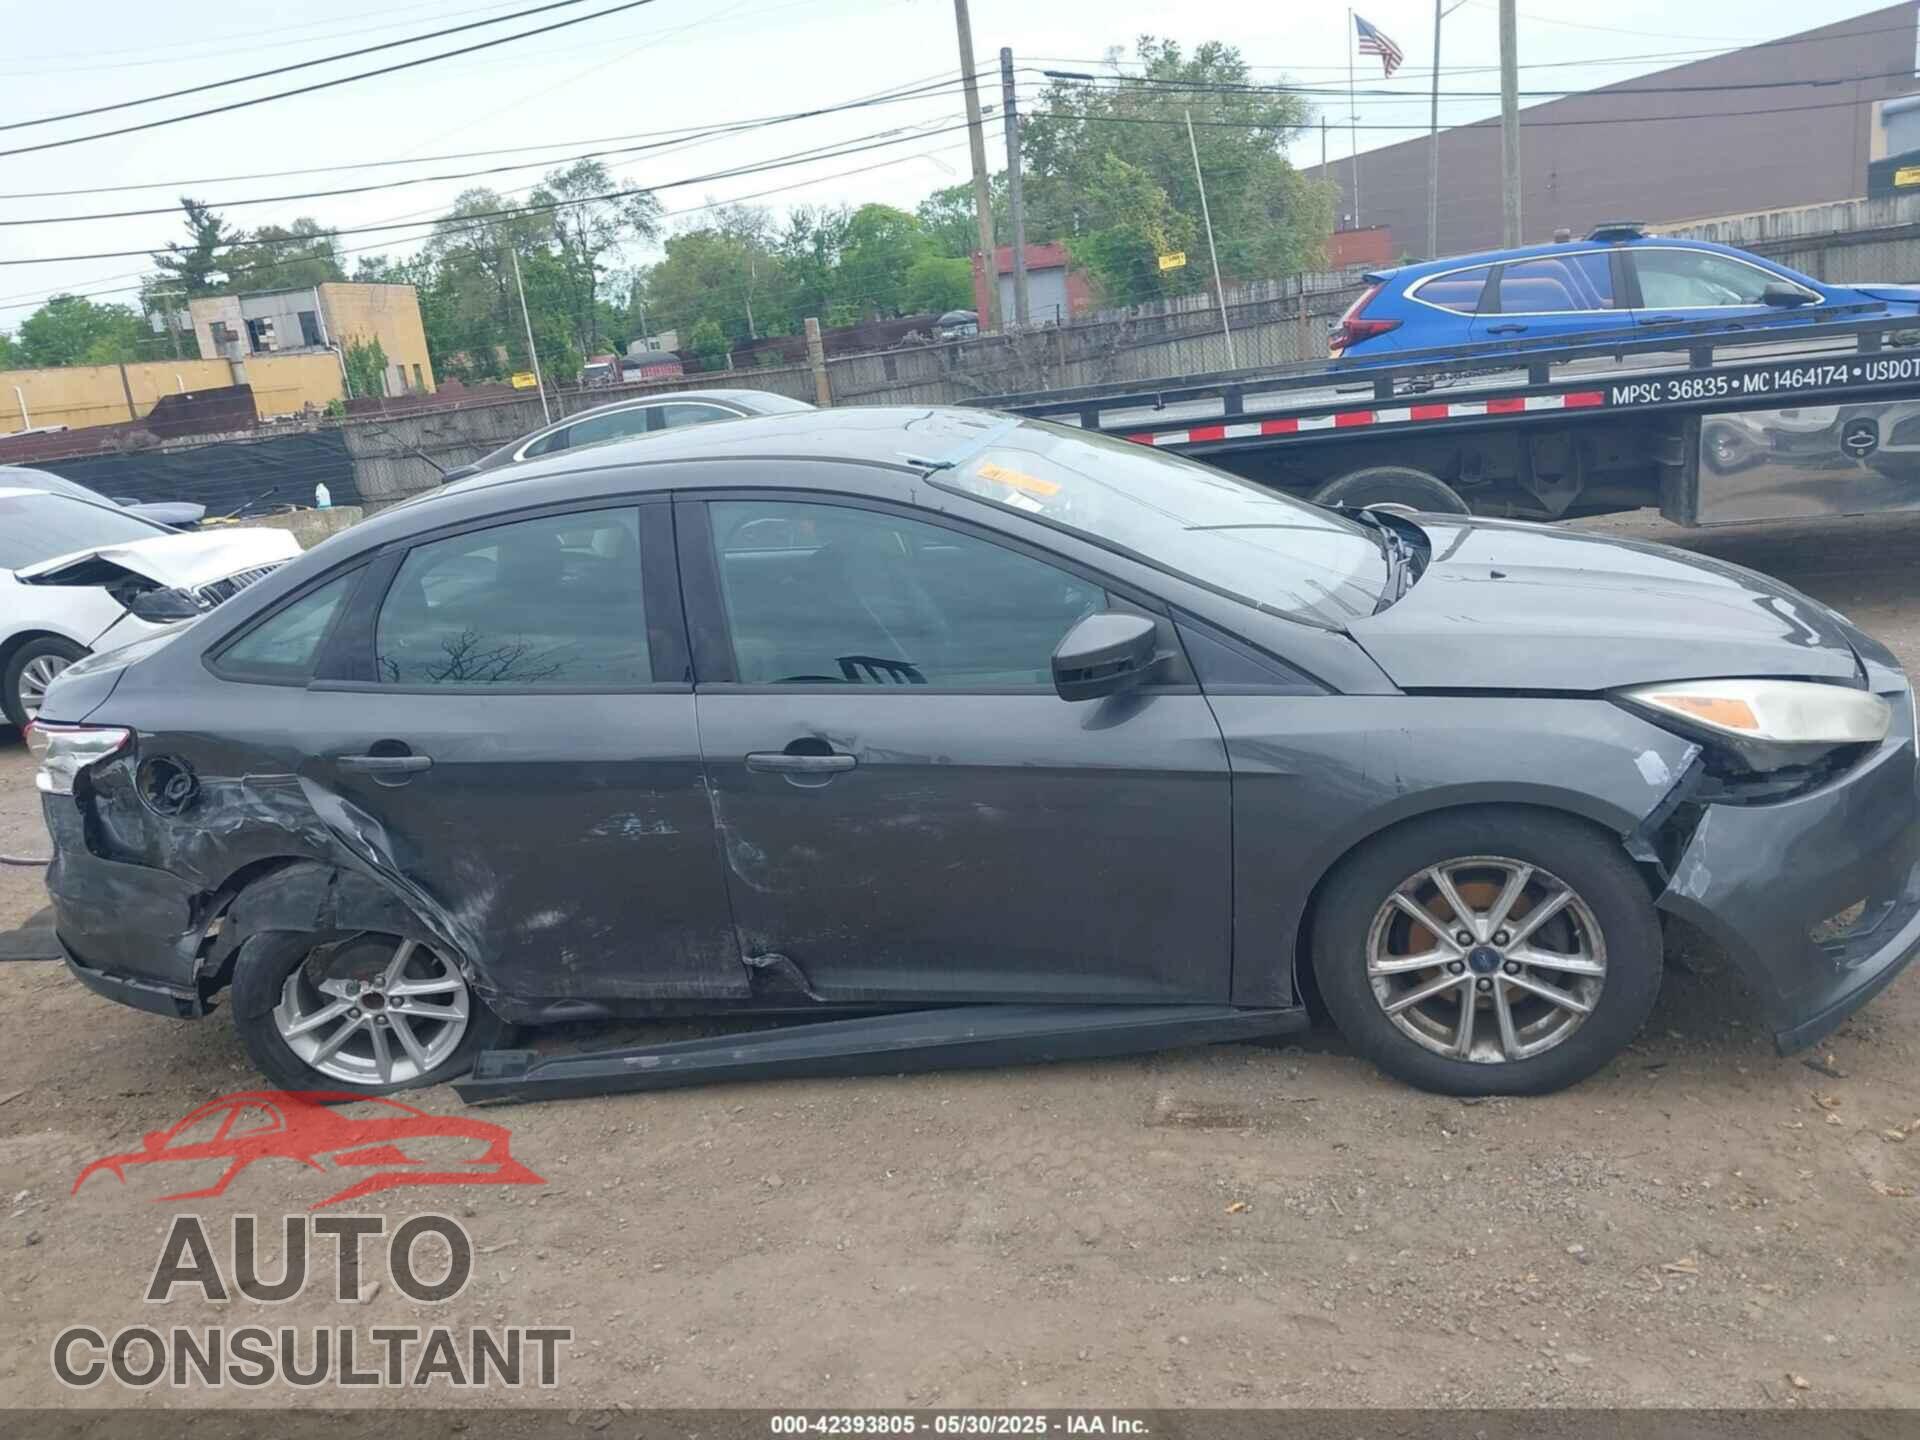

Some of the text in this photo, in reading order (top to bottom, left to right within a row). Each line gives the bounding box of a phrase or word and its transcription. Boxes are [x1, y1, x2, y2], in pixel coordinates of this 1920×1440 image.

[1612, 358, 1920, 405] MPSC 36835 MC 1464174 USDOT
